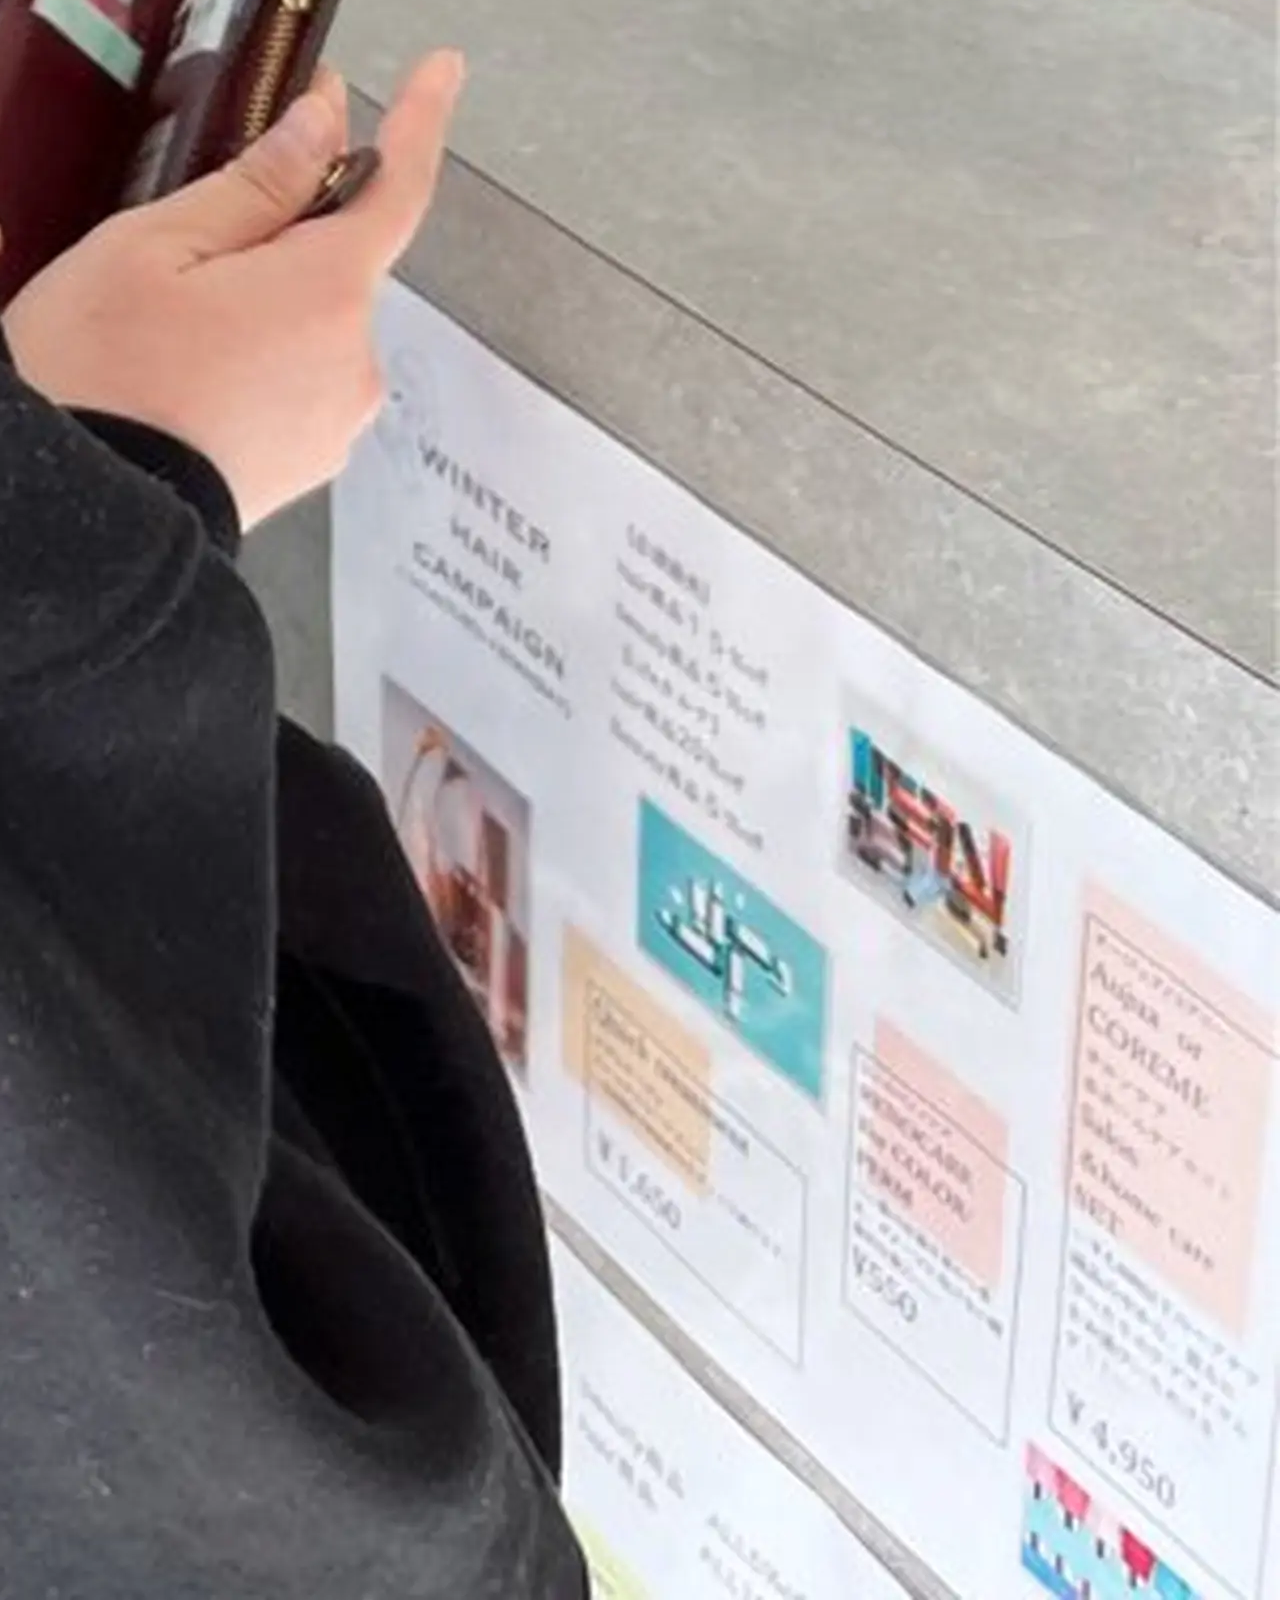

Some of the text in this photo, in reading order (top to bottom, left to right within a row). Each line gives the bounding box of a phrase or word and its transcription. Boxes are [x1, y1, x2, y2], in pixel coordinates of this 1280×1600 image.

[417, 433, 551, 564] WINTER
[450, 514, 522, 591] HAIR
[412, 540, 565, 681] CAMPAIGN
